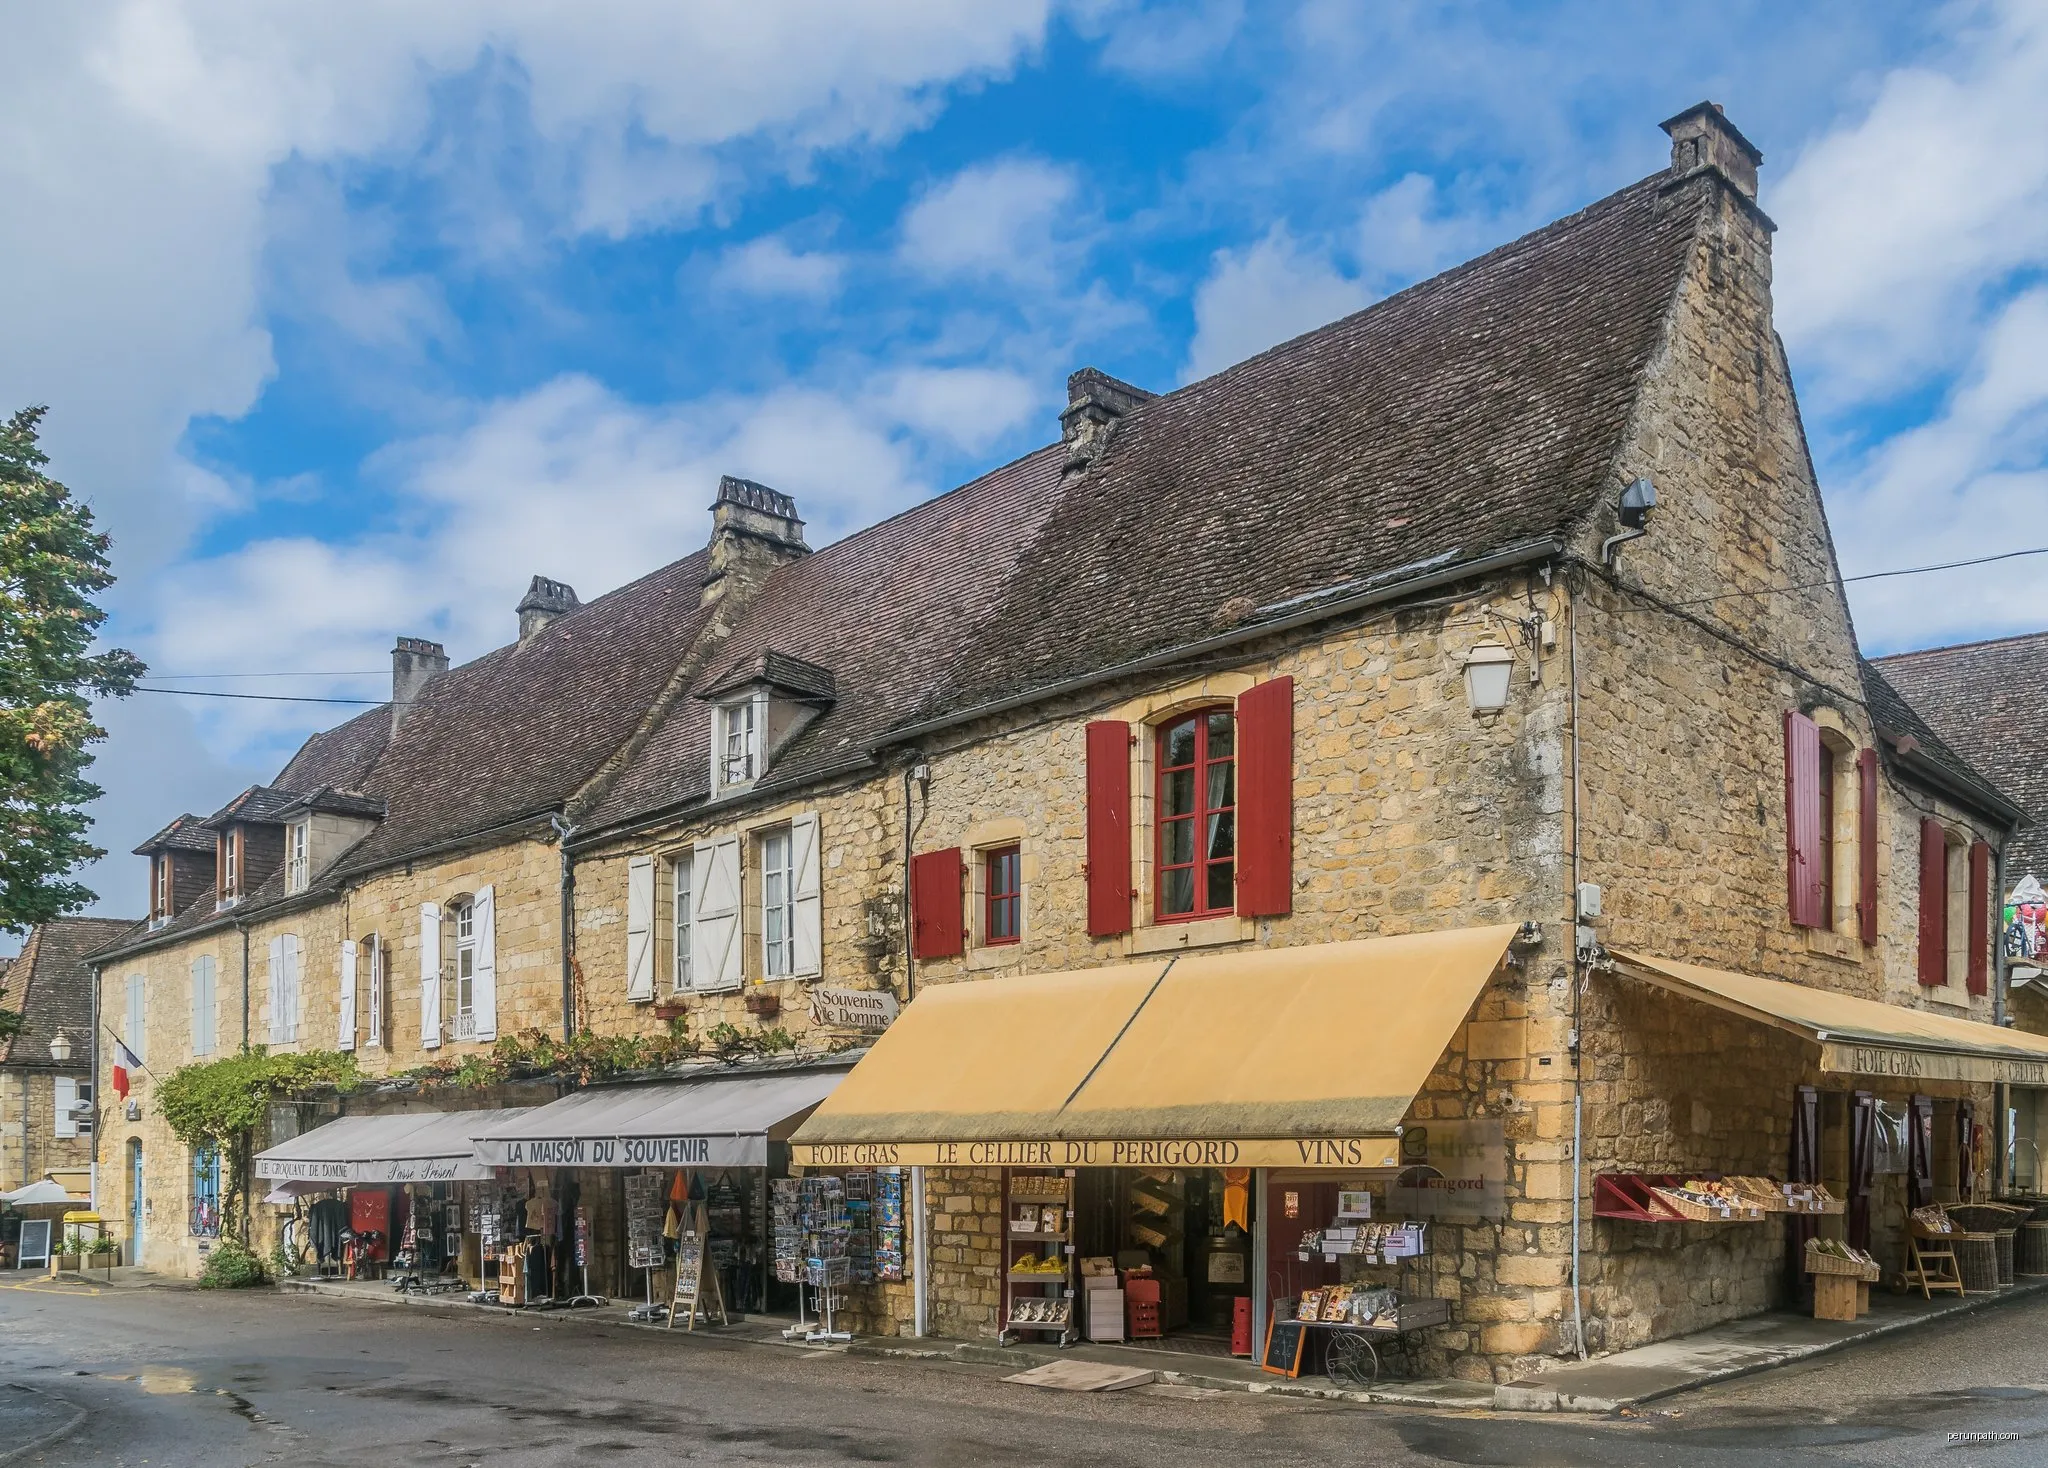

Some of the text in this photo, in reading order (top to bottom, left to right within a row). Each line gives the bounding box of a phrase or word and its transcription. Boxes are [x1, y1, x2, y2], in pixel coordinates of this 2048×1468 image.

[822, 990, 884, 1009] Souvenirs
[839, 1008, 889, 1026] Domme
[1856, 1048, 1887, 1073] FOIE
[1890, 1051, 1922, 1076] GRAS
[2008, 1061, 2045, 1083] CELLIER
[507, 1139, 710, 1163] LA MAISON DU SOUVENIR
[811, 1143, 899, 1164] FOIE GRAS
[936, 1140, 1239, 1165] LE CELLIER DU PERIGORD
[1296, 1139, 1362, 1165] VINS
[262, 1163, 269, 1174] LE
[272, 1163, 306, 1178] CROQUANT
[309, 1164, 319, 1177] DE
[387, 1158, 458, 1180] Passé Présent
